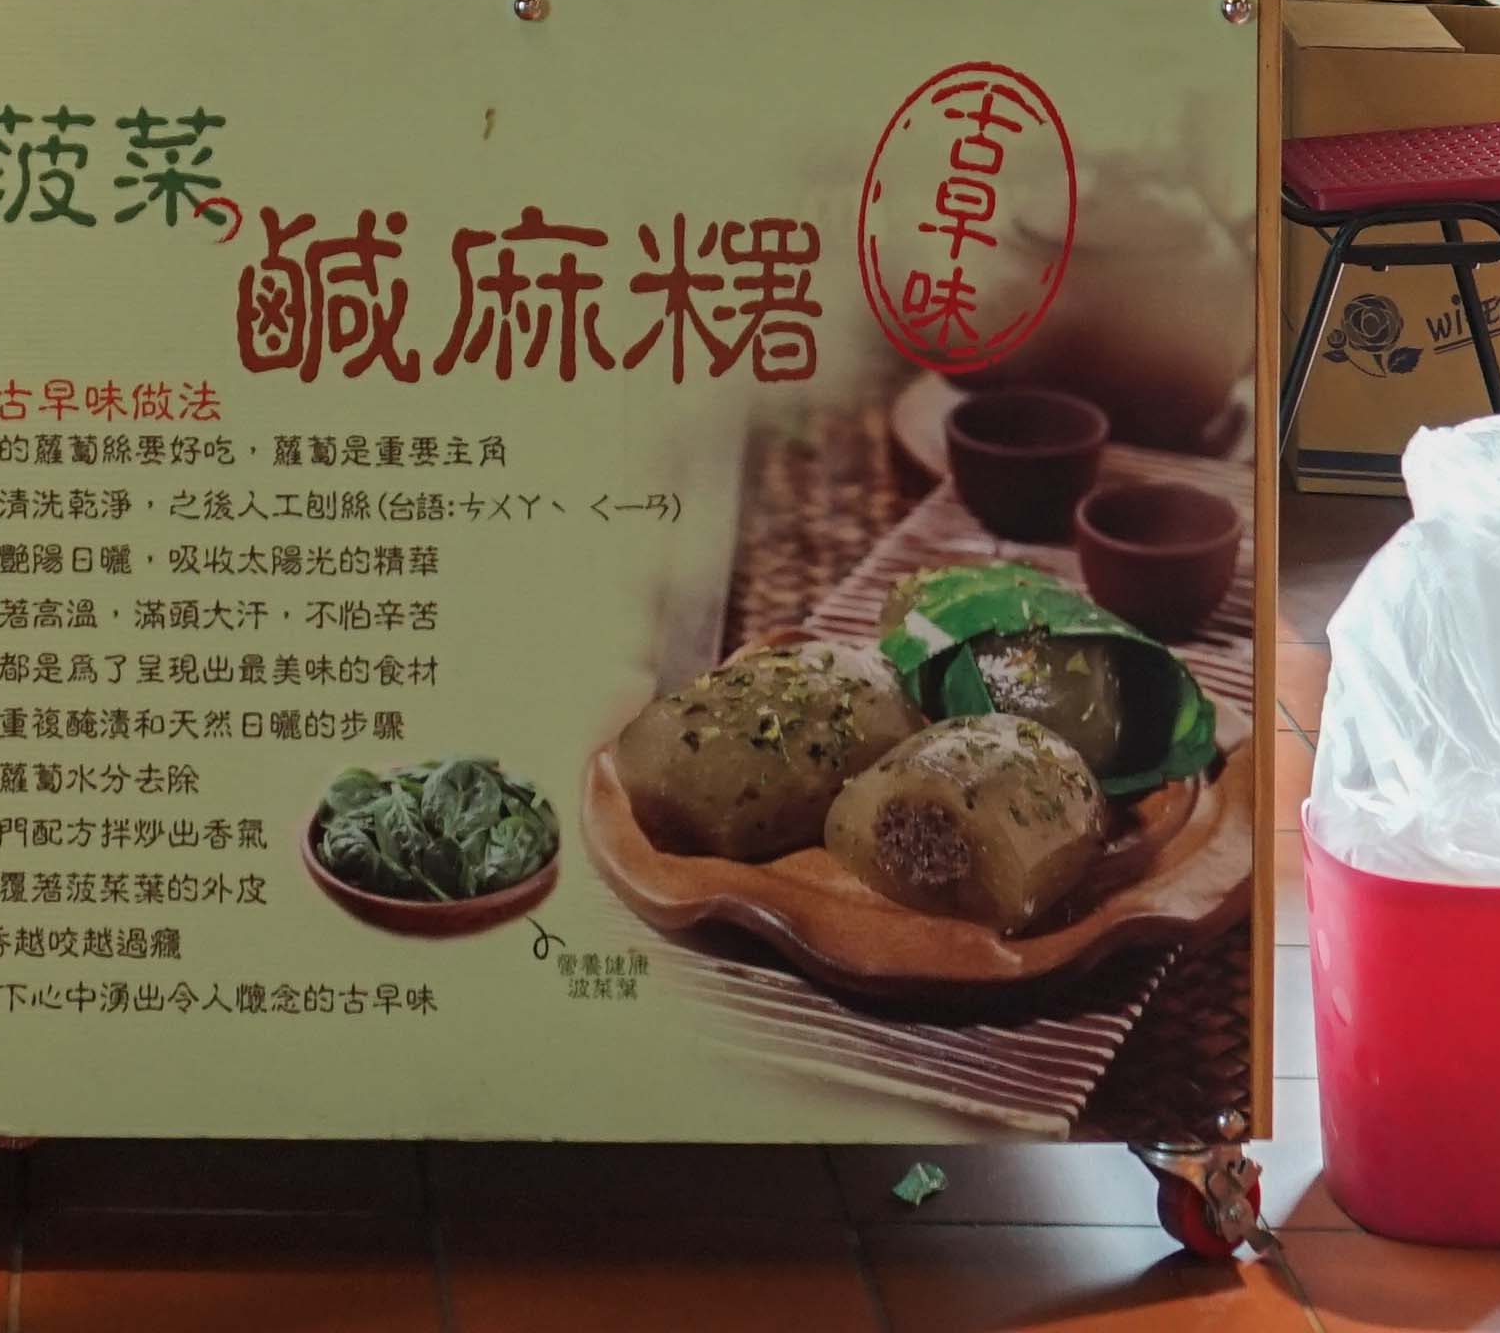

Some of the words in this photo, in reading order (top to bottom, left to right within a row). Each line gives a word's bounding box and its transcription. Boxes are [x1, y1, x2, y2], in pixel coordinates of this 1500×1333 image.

[237, 205, 823, 385] 鹹麻糬
[903, 93, 1022, 347] 古早味
